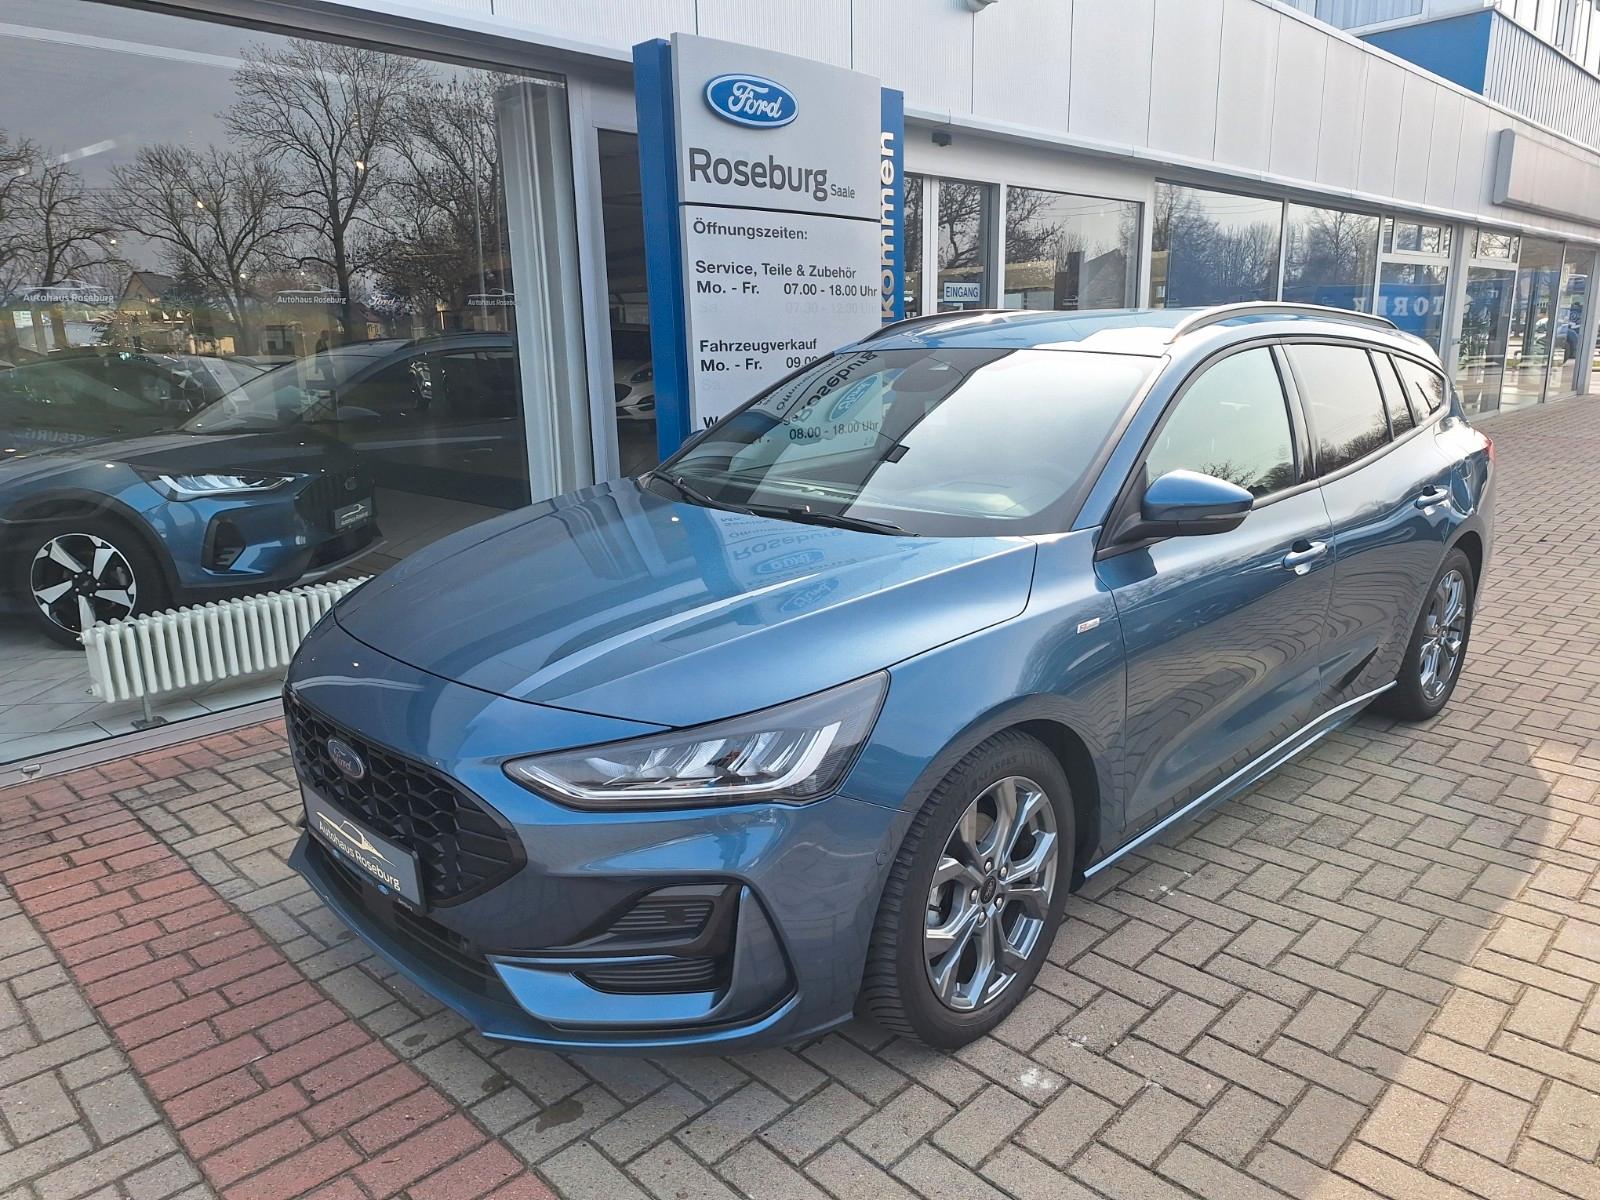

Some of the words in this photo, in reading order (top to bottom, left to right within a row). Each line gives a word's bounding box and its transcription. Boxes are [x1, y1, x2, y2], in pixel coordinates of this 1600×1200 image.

[688, 147, 828, 202] Roseburg
[830, 184, 855, 199] Saale
[693, 217, 808, 240] Öffnungszeiten:
[695, 259, 757, 277] Service,
[761, 262, 793, 276] Teile
[796, 264, 806, 277] &
[809, 264, 857, 279] Zubehör
[696, 280, 726, 295] Mo.
[742, 281, 760, 295] Fr.
[784, 282, 817, 296] 07.00
[829, 284, 857, 297] 18.00
[860, 285, 878, 297] Uhr
[945, 286, 979, 298] EINGANG
[23, 293, 70, 302] Autohaus
[72, 293, 114, 303] Roseburg
[277, 295, 312, 304] Autohaus
[314, 296, 346, 305] Roseburg
[699, 338, 817, 354] Fahrzeugverkauf
[700, 359, 729, 373] Mo.
[745, 358, 762, 371] Fr.
[789, 426, 820, 440] 08.00
[833, 422, 858, 435] 18.00
[862, 419, 880, 432] Uhr
[319, 820, 354, 858] Autohaus
[355, 851, 402, 892] Roseburg
